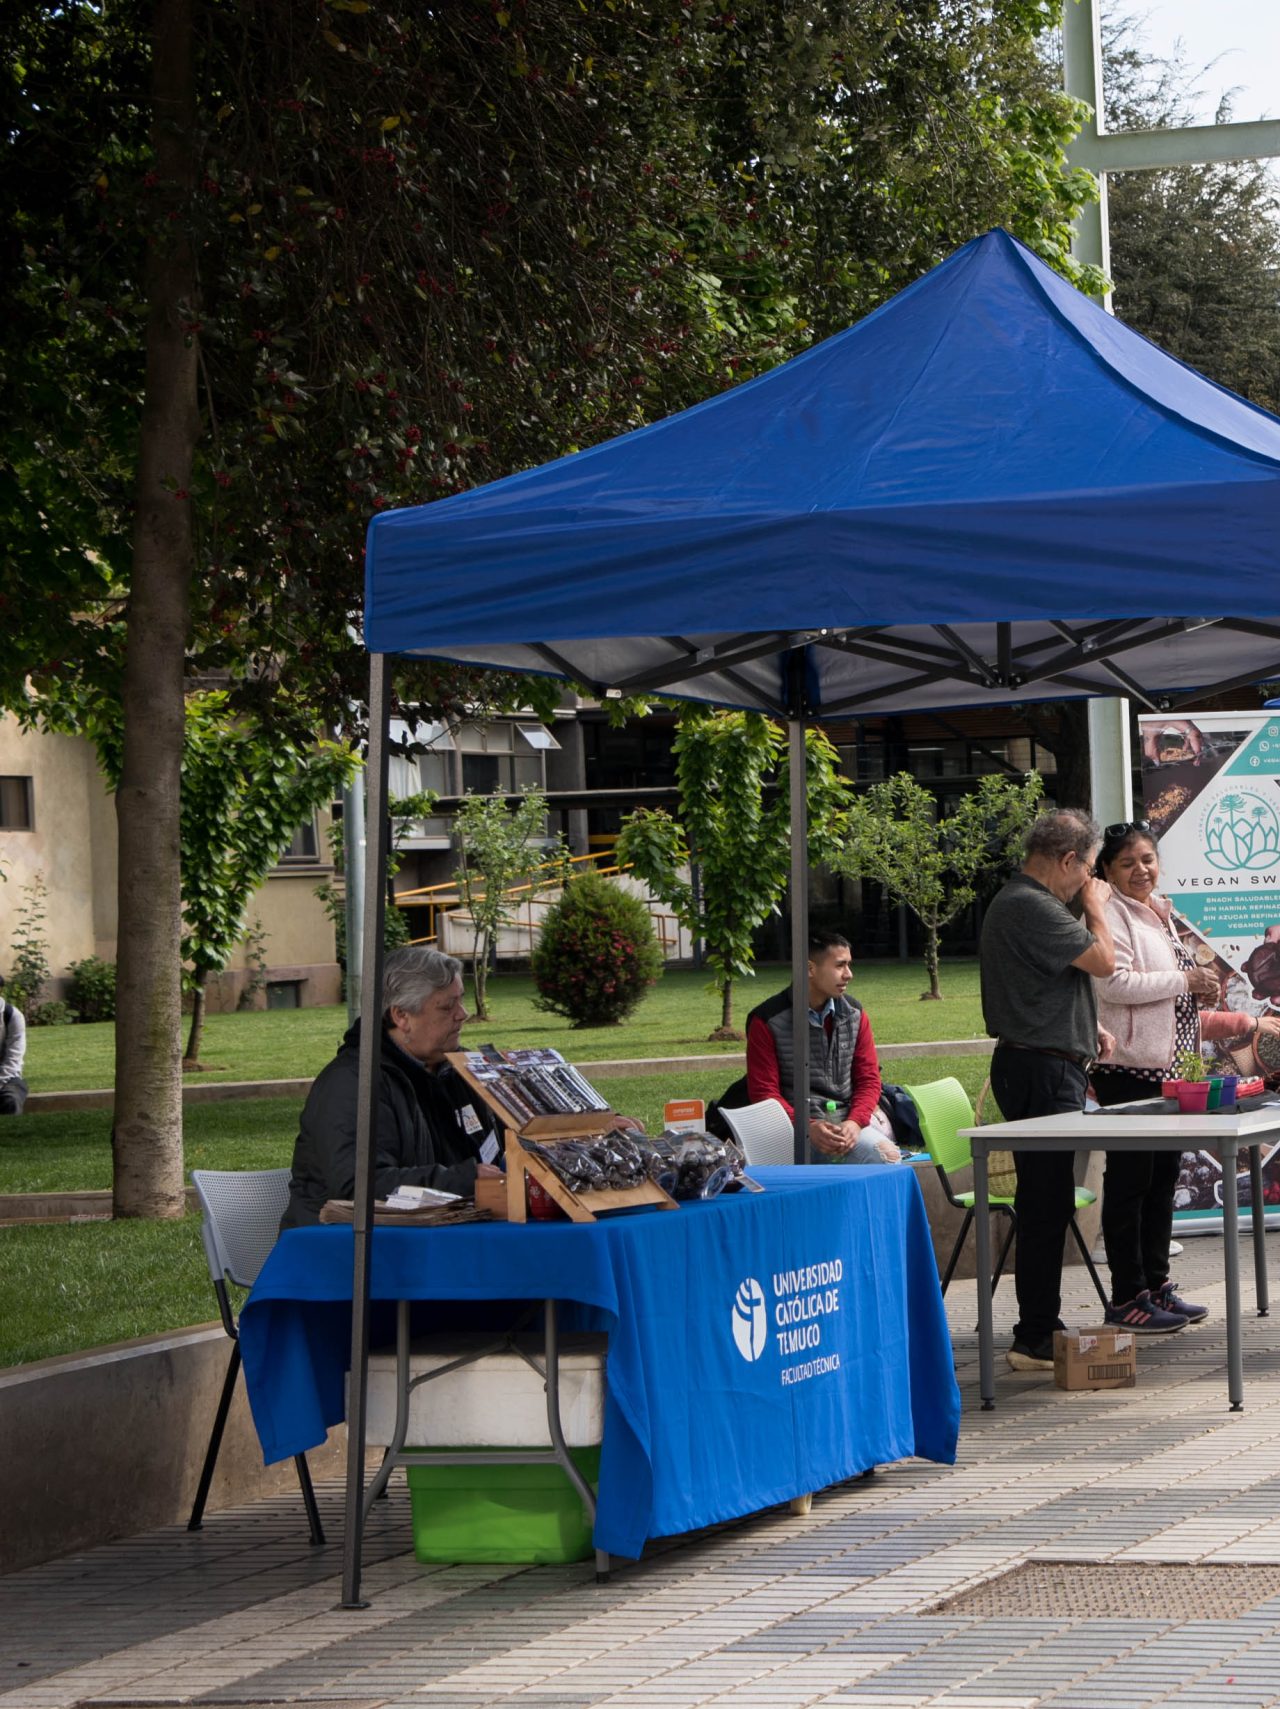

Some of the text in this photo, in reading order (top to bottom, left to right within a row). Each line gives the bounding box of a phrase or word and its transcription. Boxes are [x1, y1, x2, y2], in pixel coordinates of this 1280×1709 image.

[1177, 877, 1239, 887] VEGAN
[773, 1258, 843, 1297] UNIVERSIDAD
[775, 1288, 839, 1327] CATÓLICA DE
[781, 1353, 840, 1386] FACULTAD TÉCNICA
